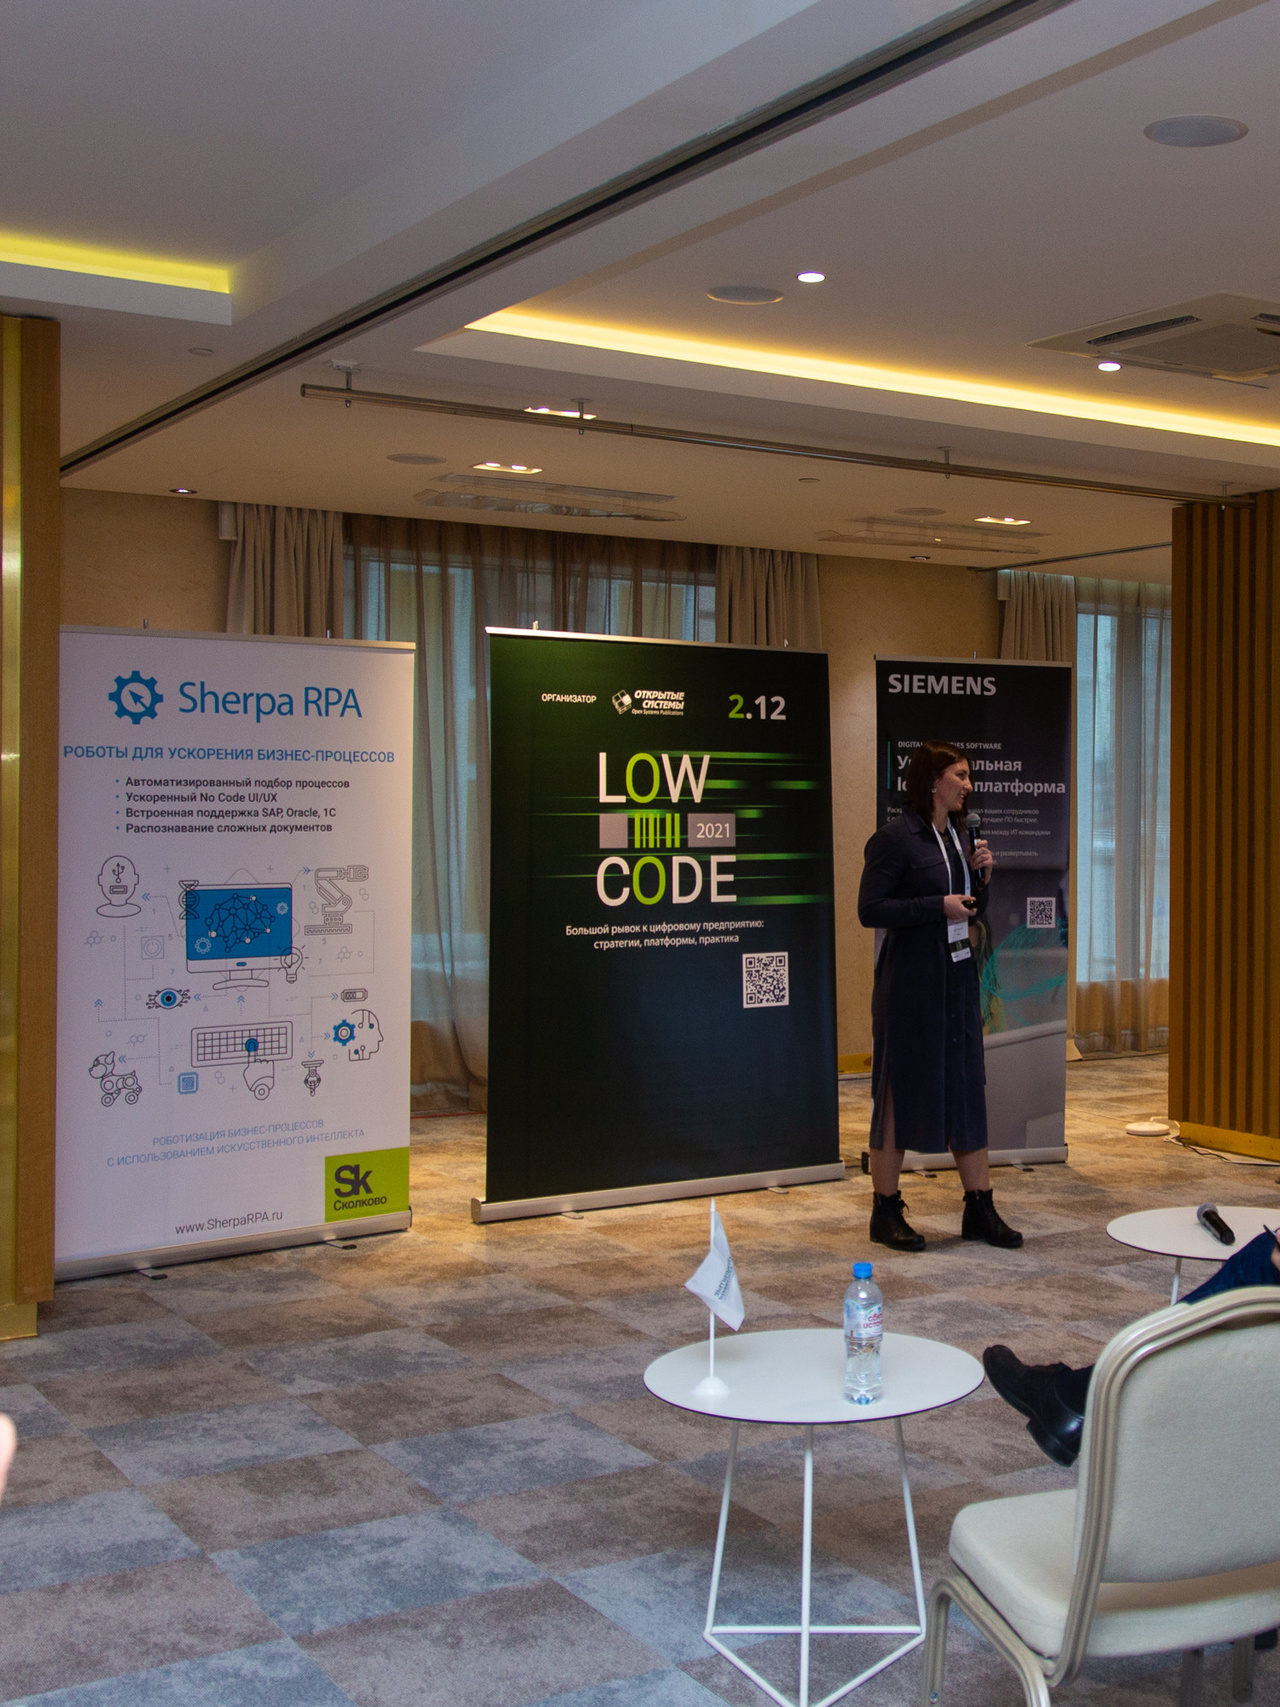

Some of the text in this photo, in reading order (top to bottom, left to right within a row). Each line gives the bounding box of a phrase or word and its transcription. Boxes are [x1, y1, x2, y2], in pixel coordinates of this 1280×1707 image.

[888, 673, 997, 696] SIEMENS
[178, 681, 363, 723] Sherpa RPA
[541, 693, 597, 704] ОРГАНИЗАТОР
[634, 689, 685, 701] ОТКРЫТЫЕ
[642, 700, 685, 710] СИСТЕМЫ
[728, 694, 786, 721] 2.12
[63, 745, 395, 764] РОБОТЫ ДЛЯ УСКОРЕНИЯ БИЗНЕС-ПРОЦЕССОВ
[966, 742, 1002, 750] SOFTWARE
[125, 777, 350, 791] Автоматизированный подбор процессов
[599, 752, 711, 804] LOW
[974, 779, 1066, 797] платформа
[125, 792, 278, 805] Ускоренный No Code UI/UX
[126, 808, 194, 820] Встроенная
[197, 809, 260, 820] поддержка
[262, 807, 284, 819] SAP,
[286, 807, 321, 819] Oracle,
[126, 823, 333, 835] Распознавание сложных документов
[696, 822, 731, 839] 2021
[596, 854, 737, 907] CODE
[565, 920, 765, 936] Большой рывок к цифровому предприятию:
[593, 935, 739, 950] стратегии, платформы, практика
[152, 1119, 324, 1147] РОБОТИЗАЦИЯ БИЗНЕС-ПРОЦЕССОВ
[106, 1128, 365, 1168] С ИСПОЛЬЗОВАНИЕМ ИСКУССТВЕННОГО ИНТЕЛЛЕКТА
[334, 1164, 373, 1198] Sk
[333, 1196, 387, 1211] Сколково
[175, 1211, 283, 1235] www.SherpaRPA.ru
